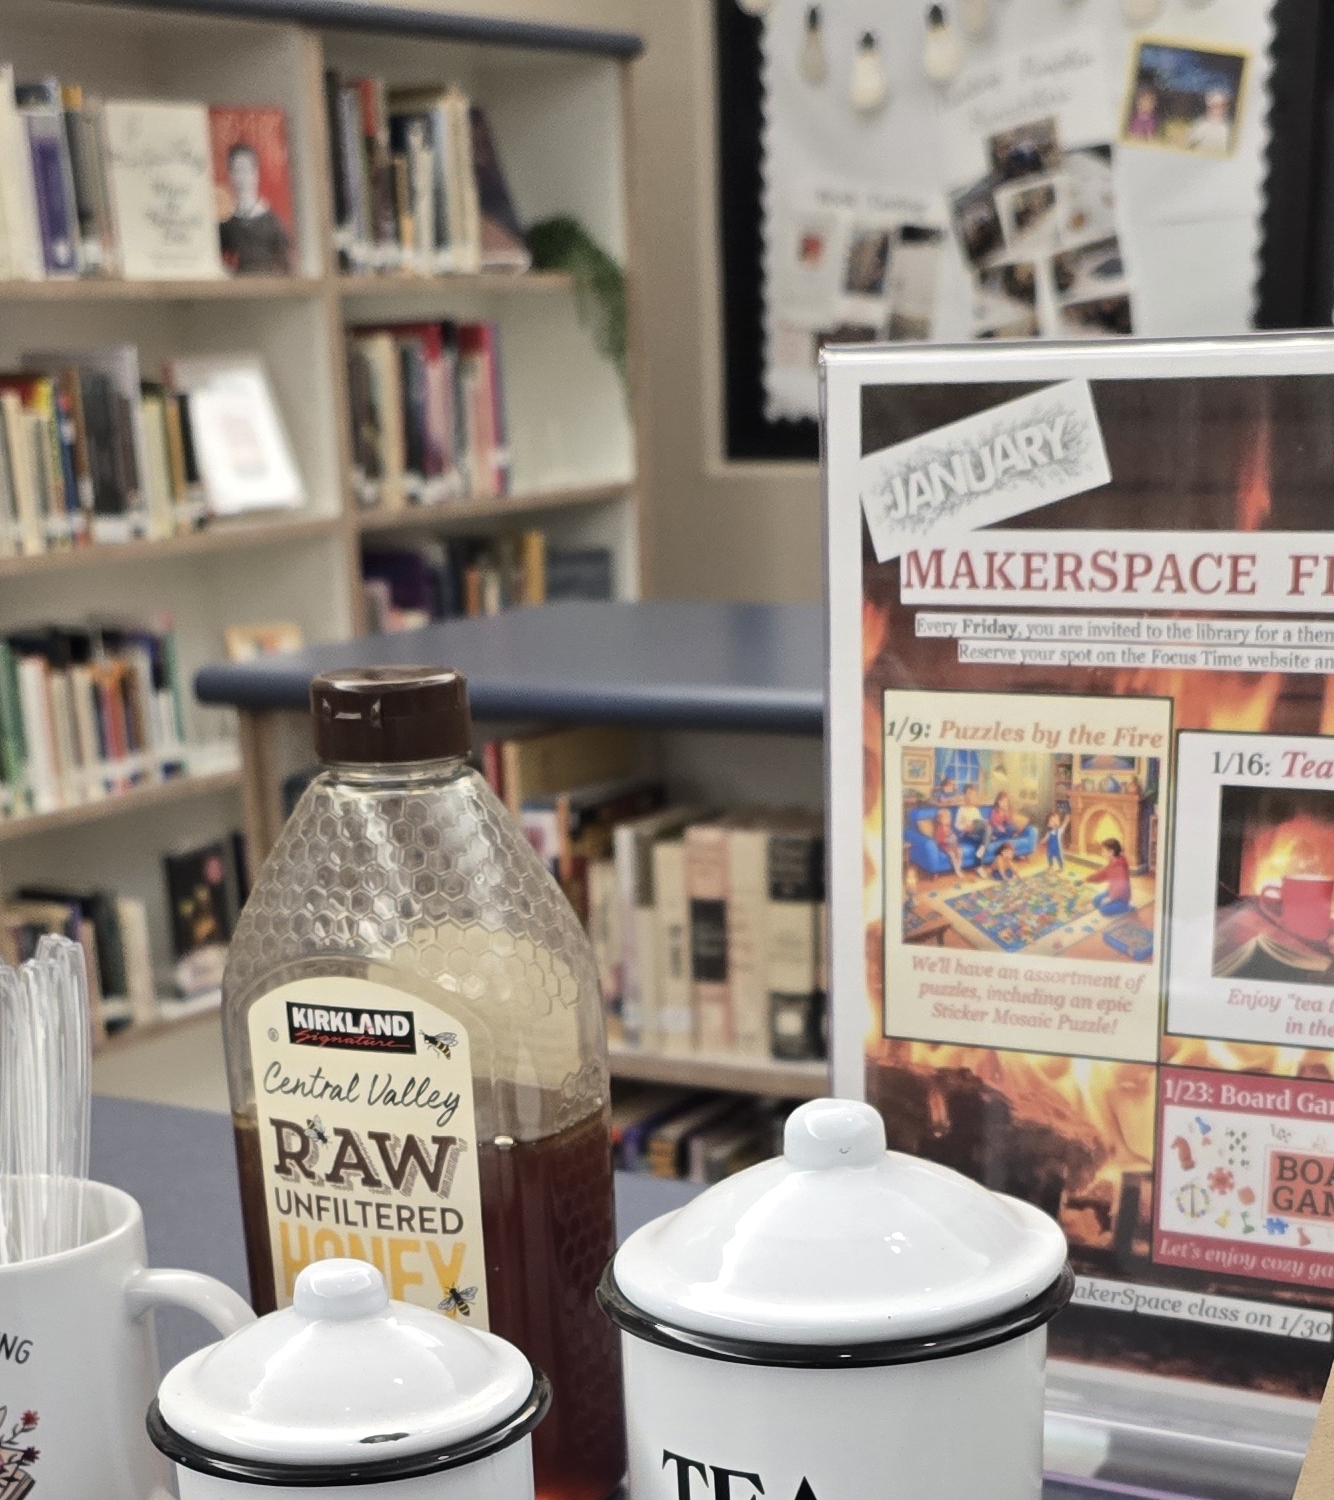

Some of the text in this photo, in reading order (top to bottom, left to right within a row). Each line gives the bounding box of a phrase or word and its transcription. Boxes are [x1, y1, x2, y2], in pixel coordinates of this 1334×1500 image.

[887, 415, 1068, 519] JANUARY
[904, 548, 1258, 597] MAKERSPACE
[916, 616, 958, 637] Every
[961, 617, 1024, 639] Friday,
[1025, 623, 1055, 639] you
[1058, 623, 1084, 637] are
[1087, 620, 1142, 639] invited
[1145, 623, 1164, 640] to
[1166, 621, 1193, 641] the
[1195, 622, 1252, 643] library
[1254, 623, 1280, 643] for
[1282, 628, 1294, 644] a
[961, 642, 1017, 663] Reserve
[1019, 648, 1057, 664] your
[1059, 647, 1093, 665] spot
[1095, 649, 1117, 664] on
[1120, 646, 1147, 665] the
[1150, 647, 1198, 666] Focus
[1199, 648, 1244, 668] Time
[1246, 650, 1311, 670] website
[885, 716, 1164, 749] 1/9: Puzzles by the Fire
[1212, 750, 1271, 777] 1/16:
[1281, 750, 1334, 780] Tea
[1225, 987, 1283, 1014] Enjoy
[1287, 992, 1325, 1014] "tea
[292, 1005, 411, 1037] KIRKLAND
[1284, 1015, 1305, 1036] in
[264, 1061, 461, 1127] Central Valley
[1164, 1077, 1215, 1106] 1/23:
[1219, 1083, 1293, 1112] Board
[269, 1117, 468, 1200] RAW
[274, 1187, 464, 1235] UNFILTERED
[1160, 1238, 1200, 1259] Let's
[1205, 1248, 1256, 1270] enjoy
[1073, 1281, 1332, 1338] akerSpace class on 1/30
